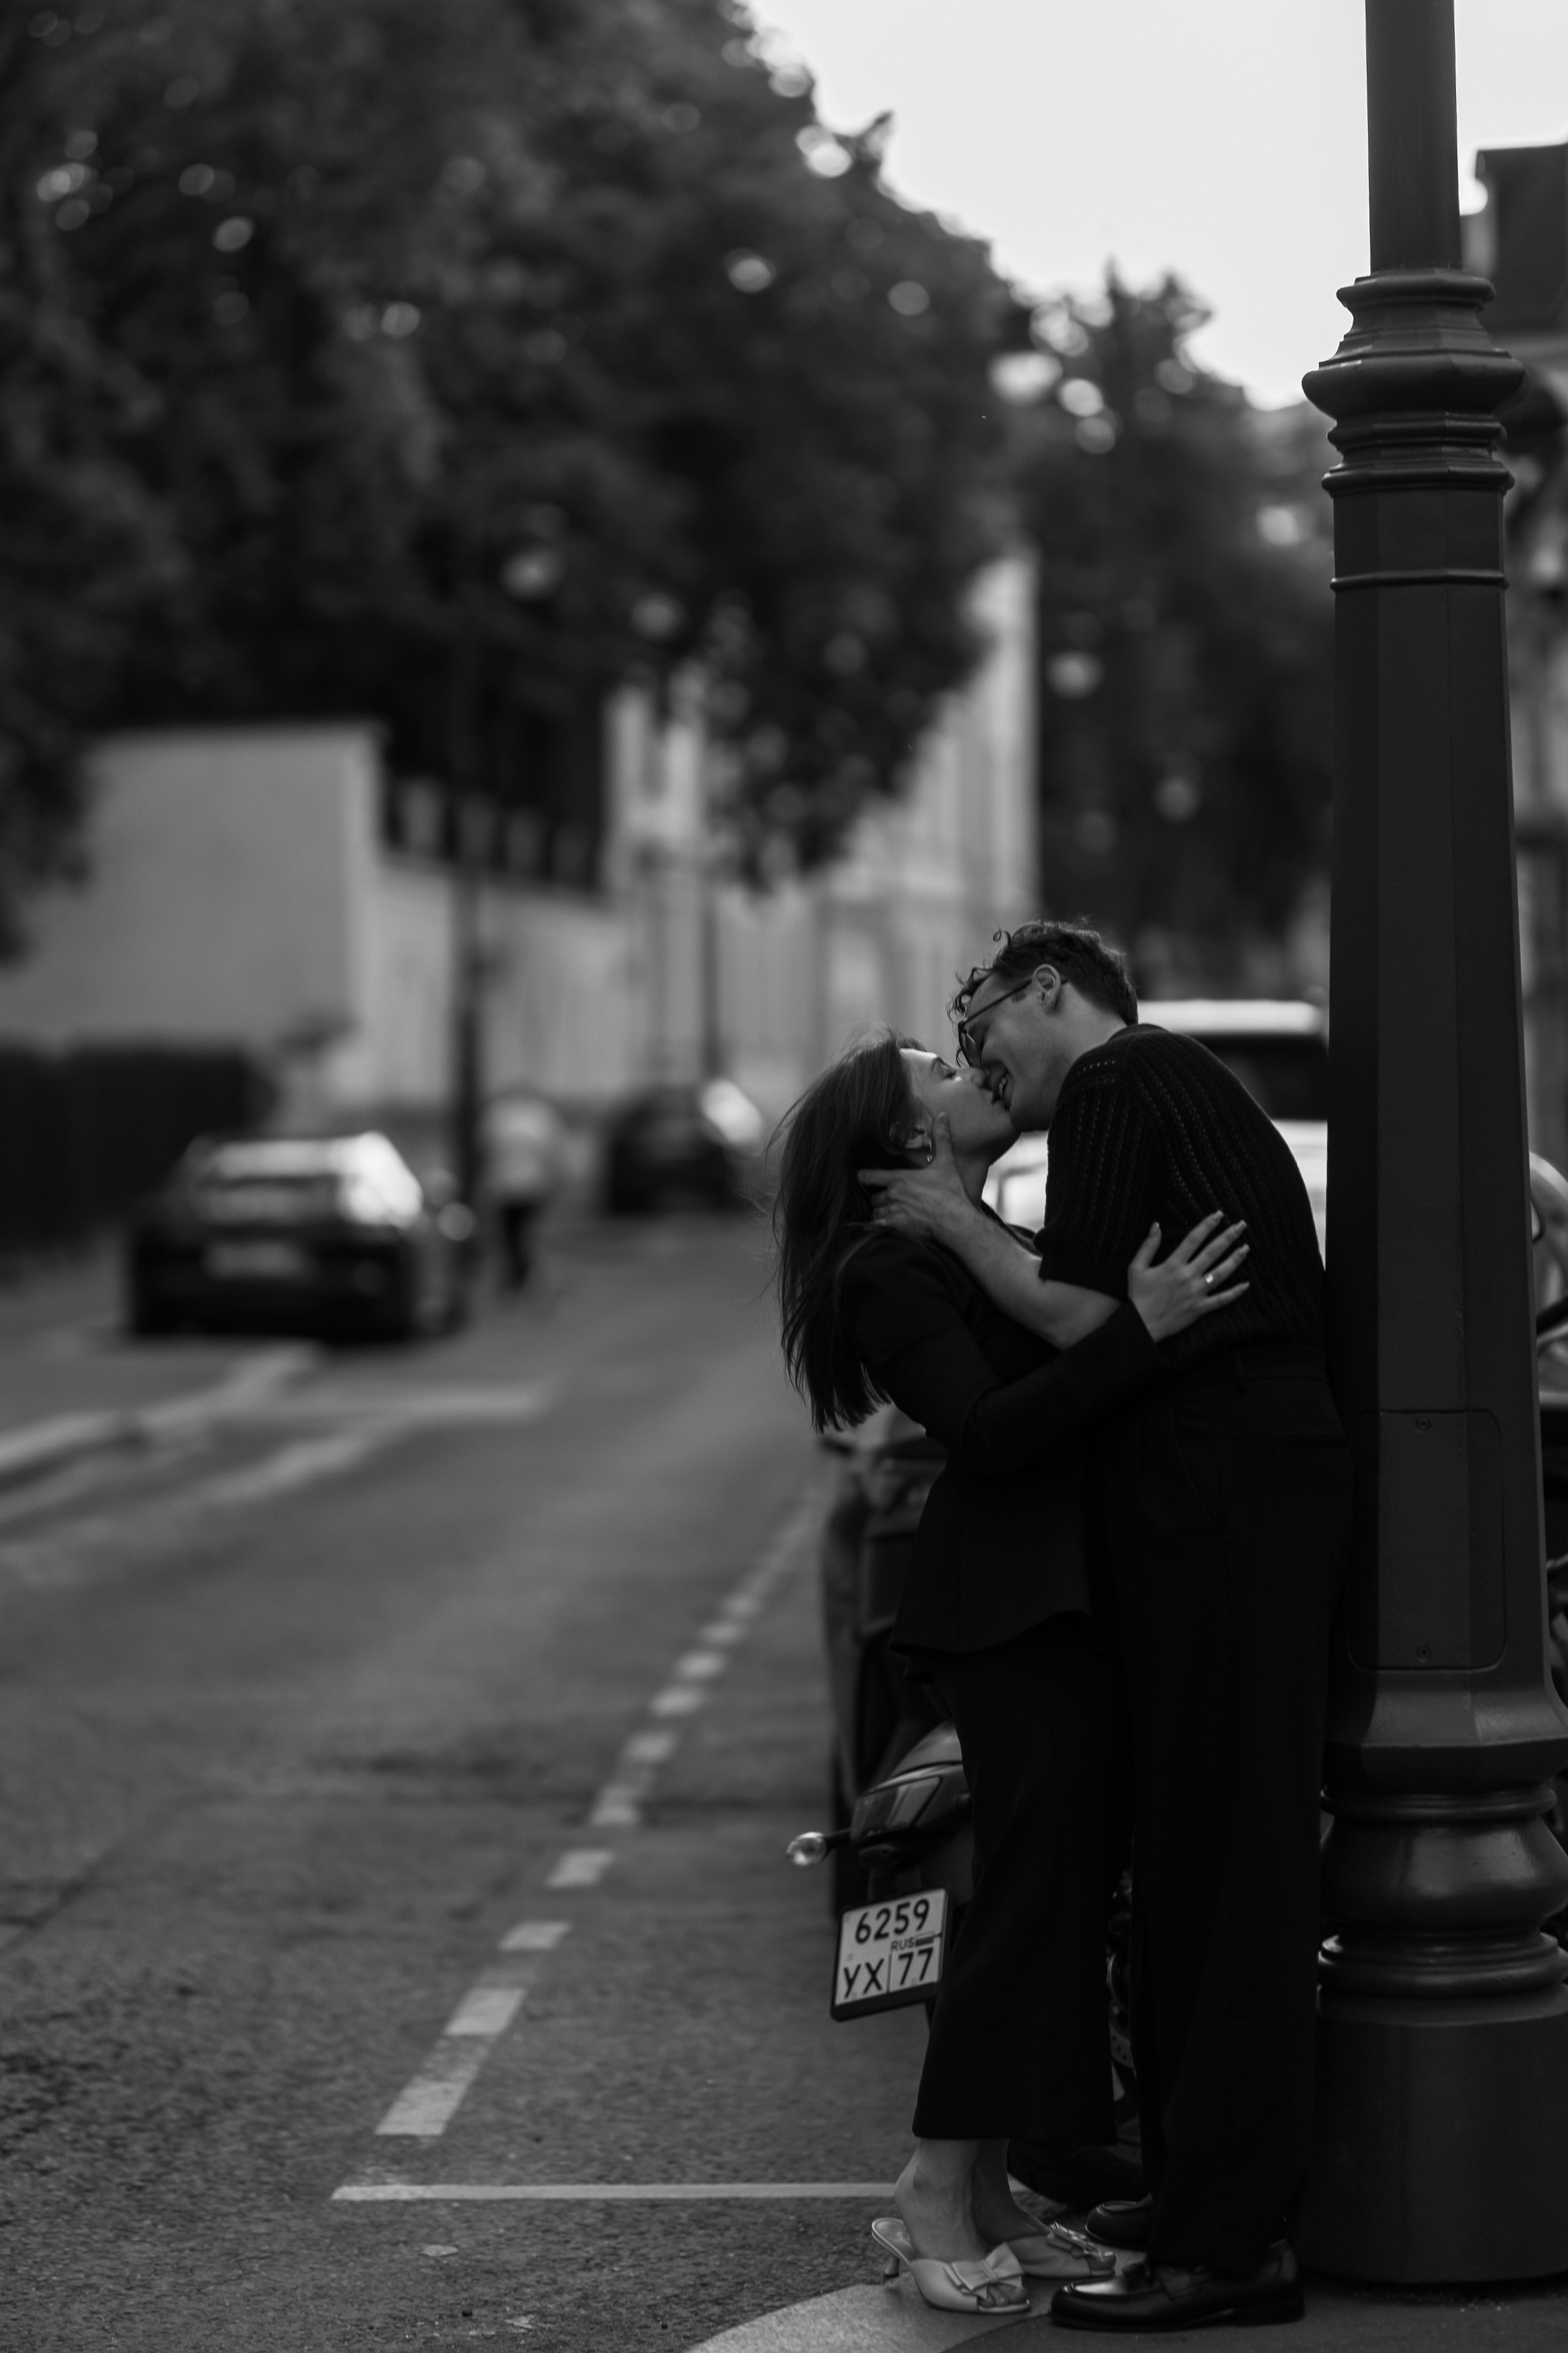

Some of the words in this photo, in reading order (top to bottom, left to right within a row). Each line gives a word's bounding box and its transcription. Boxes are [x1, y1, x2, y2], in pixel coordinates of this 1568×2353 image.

[855, 1898, 930, 1944] 6259
[891, 1937, 916, 1951] RUS
[898, 1946, 934, 1986] 77
